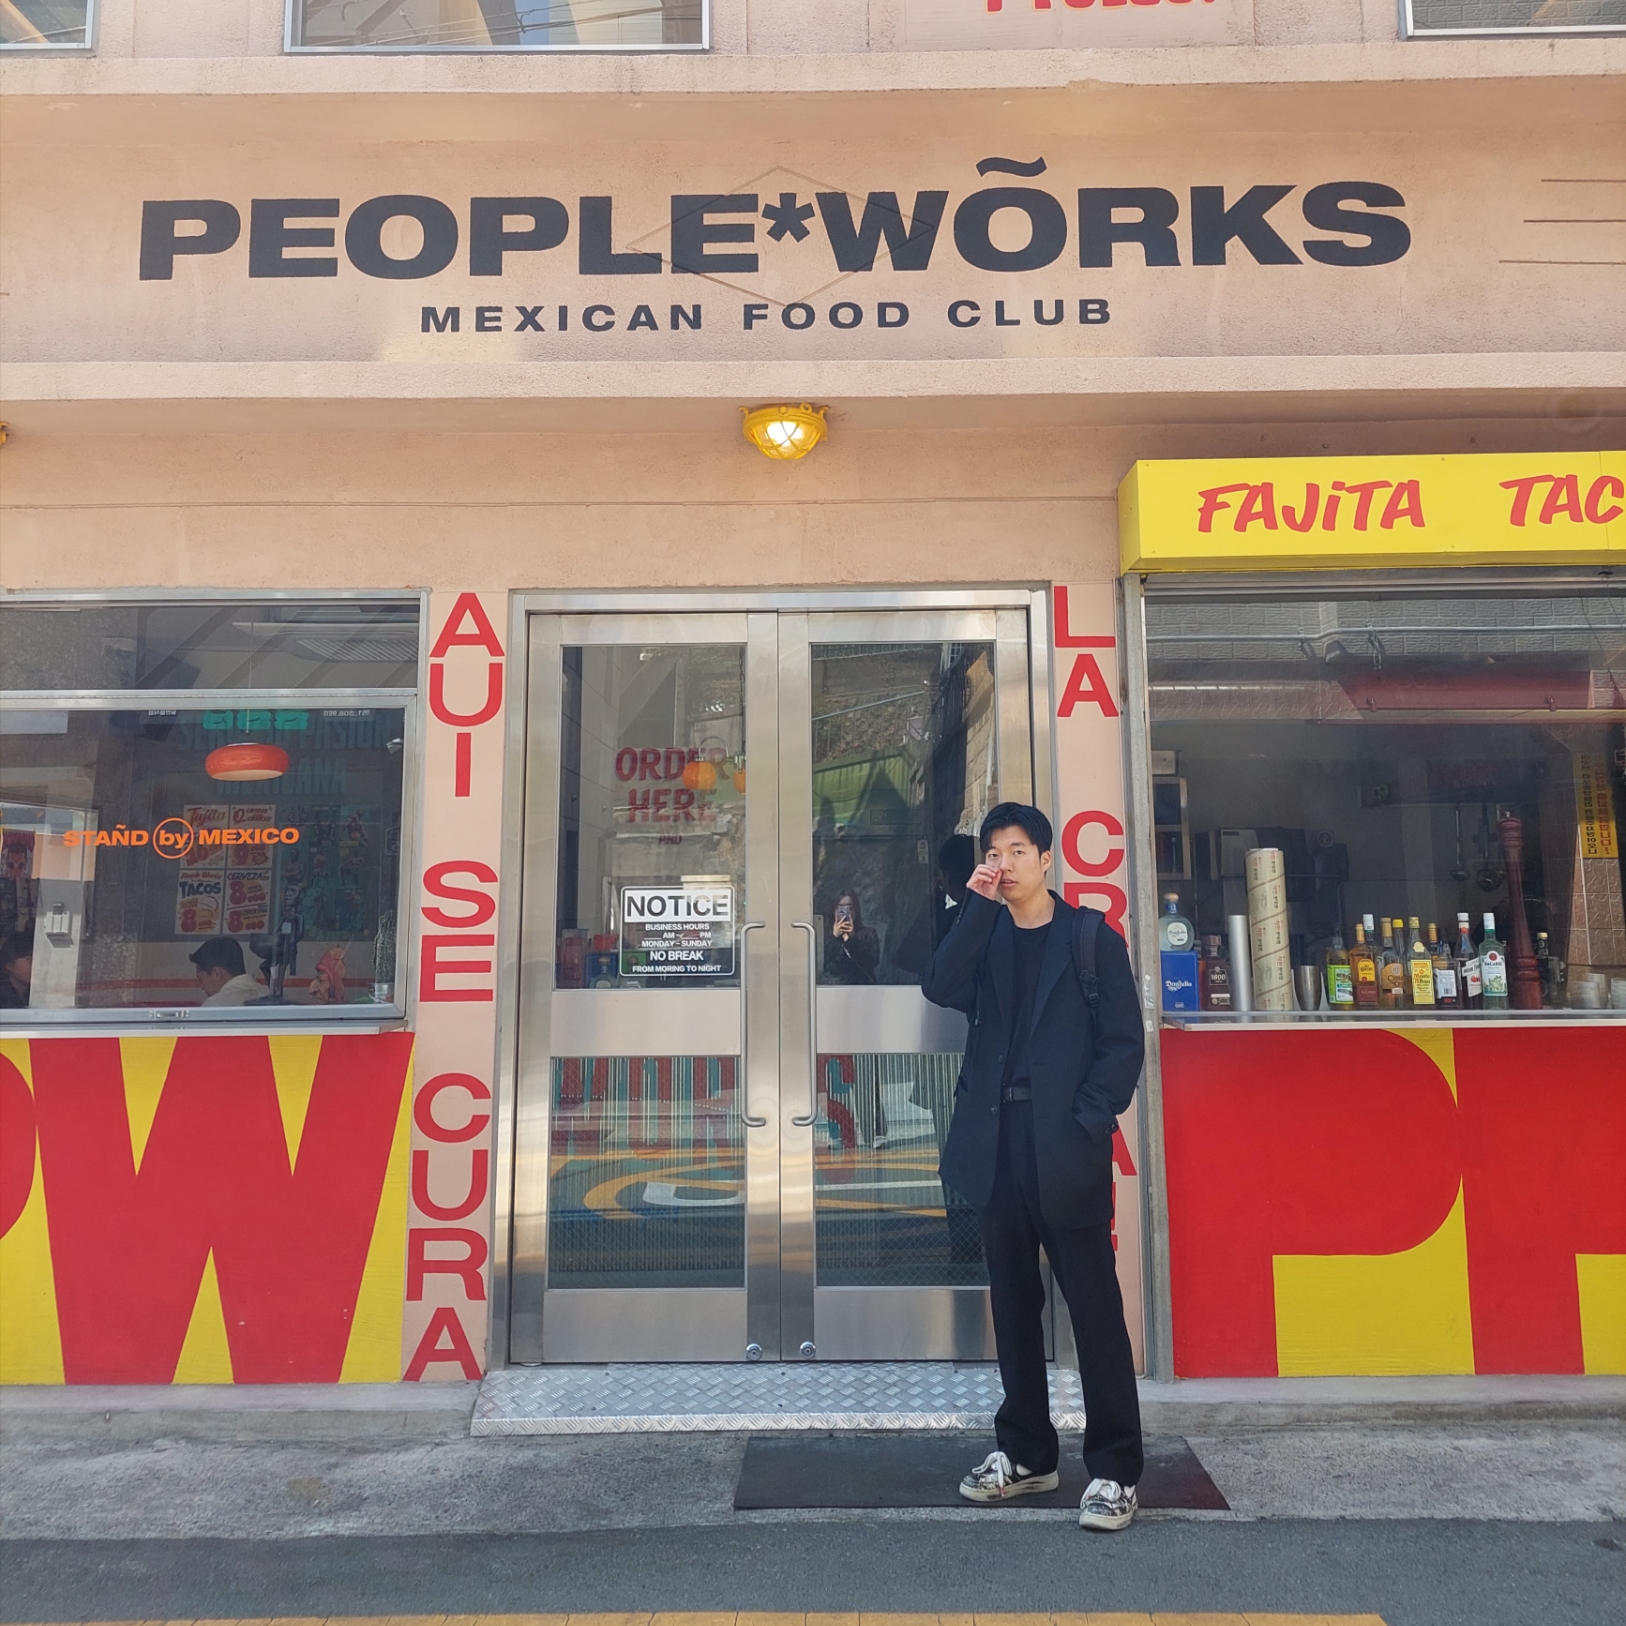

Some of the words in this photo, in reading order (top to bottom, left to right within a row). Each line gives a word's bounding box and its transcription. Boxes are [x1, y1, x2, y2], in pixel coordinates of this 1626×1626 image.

[420, 303, 704, 334] MEXICAN
[743, 301, 911, 332] FOOD
[947, 298, 1112, 328] CLUB
[1053, 586, 1119, 717] LA
[62, 824, 150, 847] STAÑD
[158, 827, 191, 850] by
[198, 827, 300, 845] MEXICO
[179, 880, 222, 899] TACOS
[627, 895, 729, 917] NOTICE
[419, 859, 499, 1002] SE
[645, 922, 683, 931] BUSINESS
[683, 922, 710, 931] HOURS
[699, 931, 712, 939] PM
[641, 940, 675, 948] MONDAY
[681, 939, 713, 948] SUNDAY
[649, 951, 666, 961] NO
[668, 950, 704, 961] BREAK
[697, 964, 722, 972] NIGHT
[402, 1072, 491, 1381] CURA
